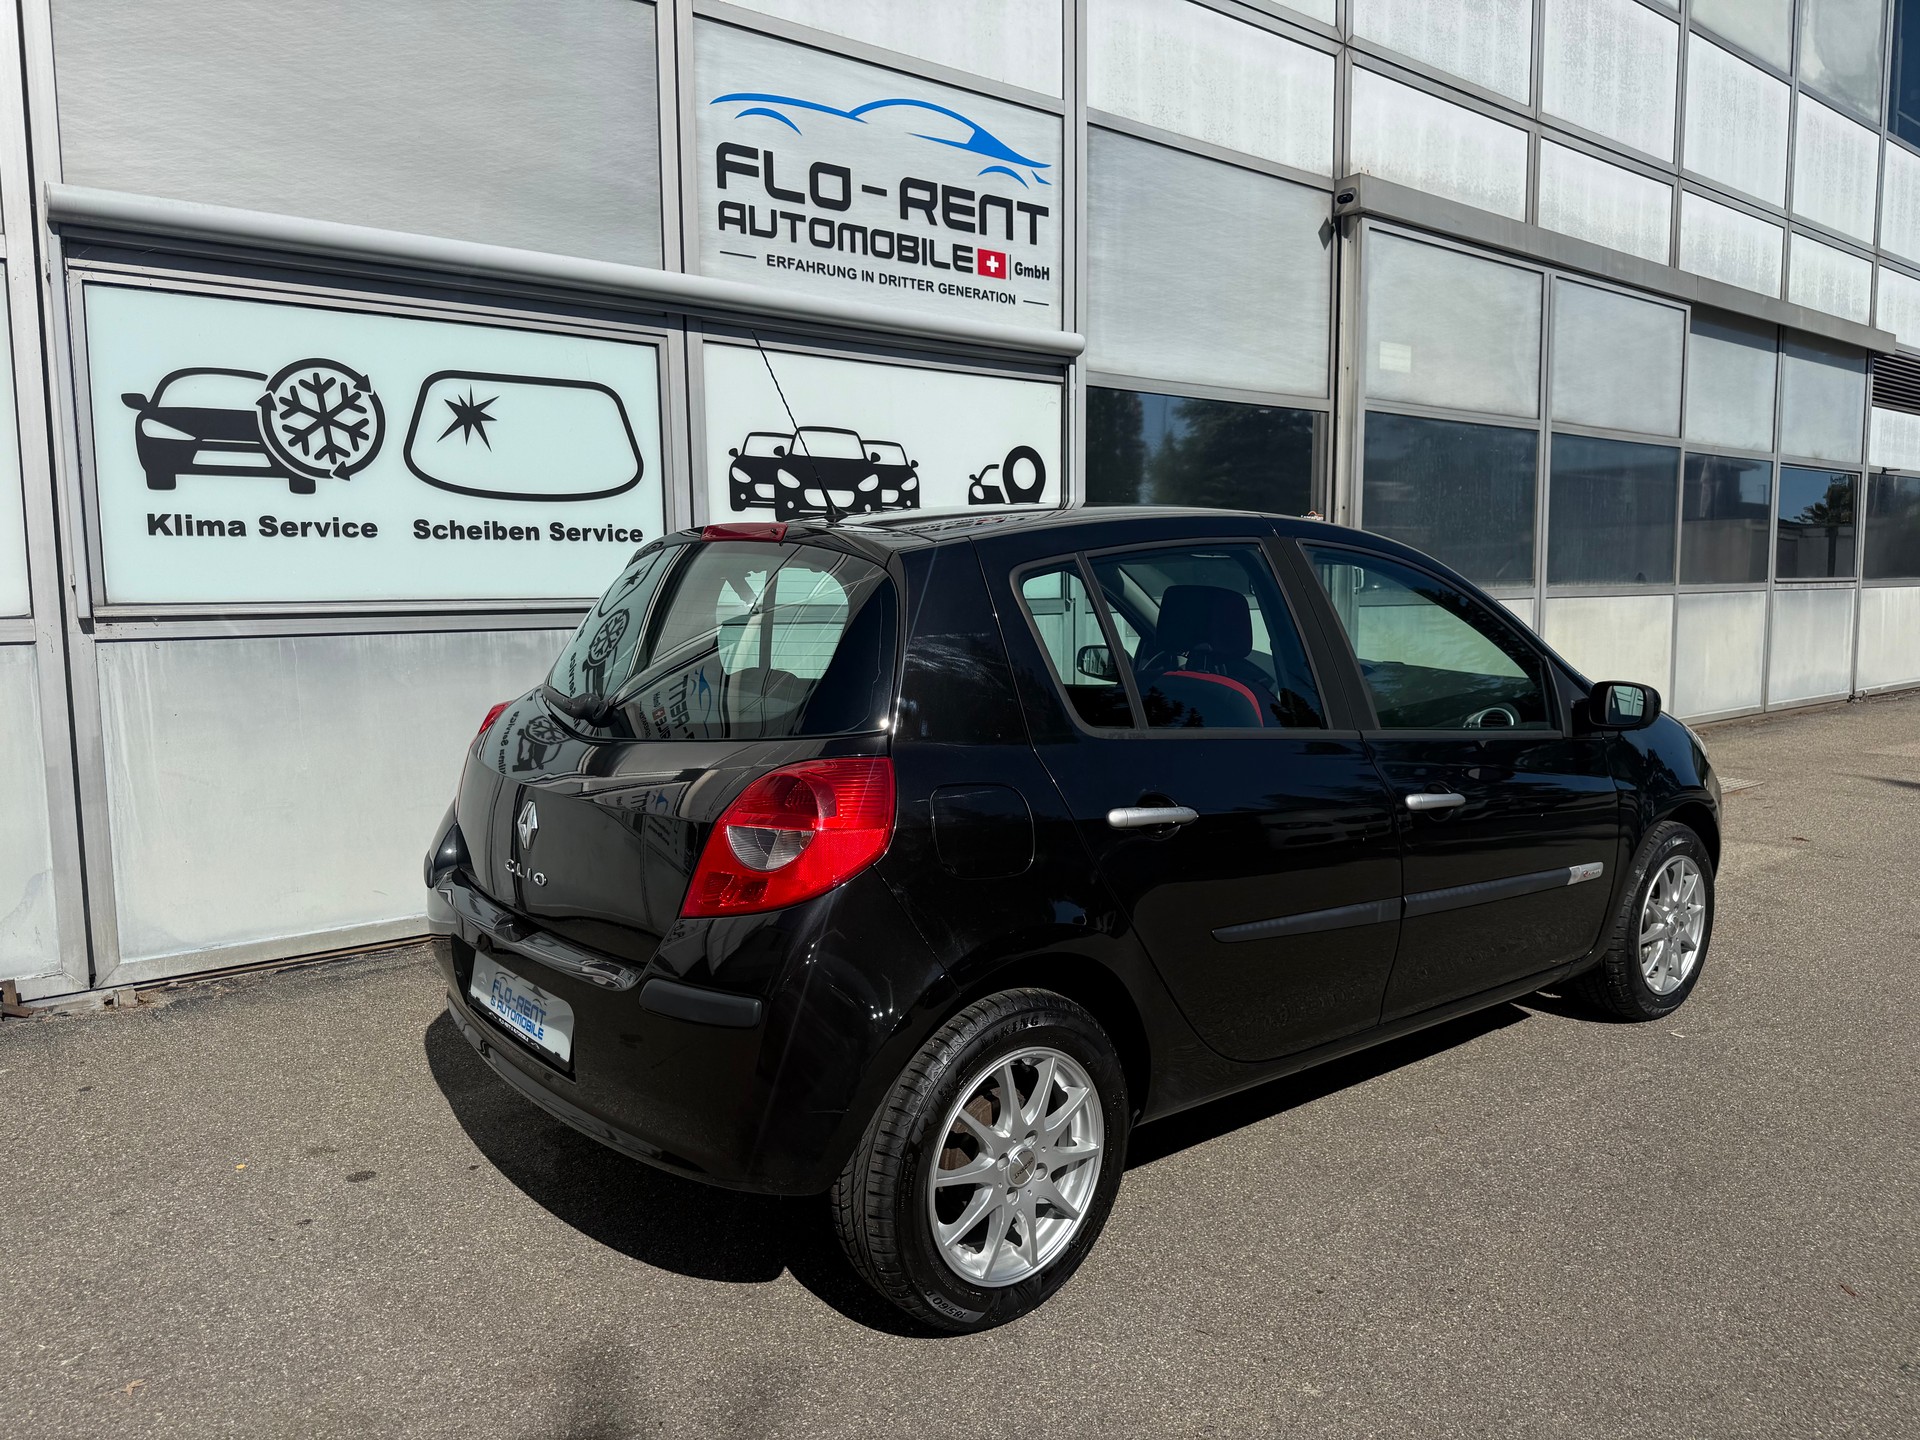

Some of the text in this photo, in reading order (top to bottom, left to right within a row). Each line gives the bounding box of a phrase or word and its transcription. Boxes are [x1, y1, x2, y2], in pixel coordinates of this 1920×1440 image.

[715, 141, 1050, 246] FLO-RENT
[717, 200, 1050, 281] AUTOMOBILE GmbH
[766, 253, 1016, 305] ERFAHRUNG IN DRITTER GENERATION
[146, 513, 379, 539] Klima Service
[413, 518, 643, 543] Scheiben Service
[504, 858, 548, 887] CLIO
[491, 978, 547, 1026] FLO-RENT
[496, 999, 545, 1041] AUTOMOBILE
